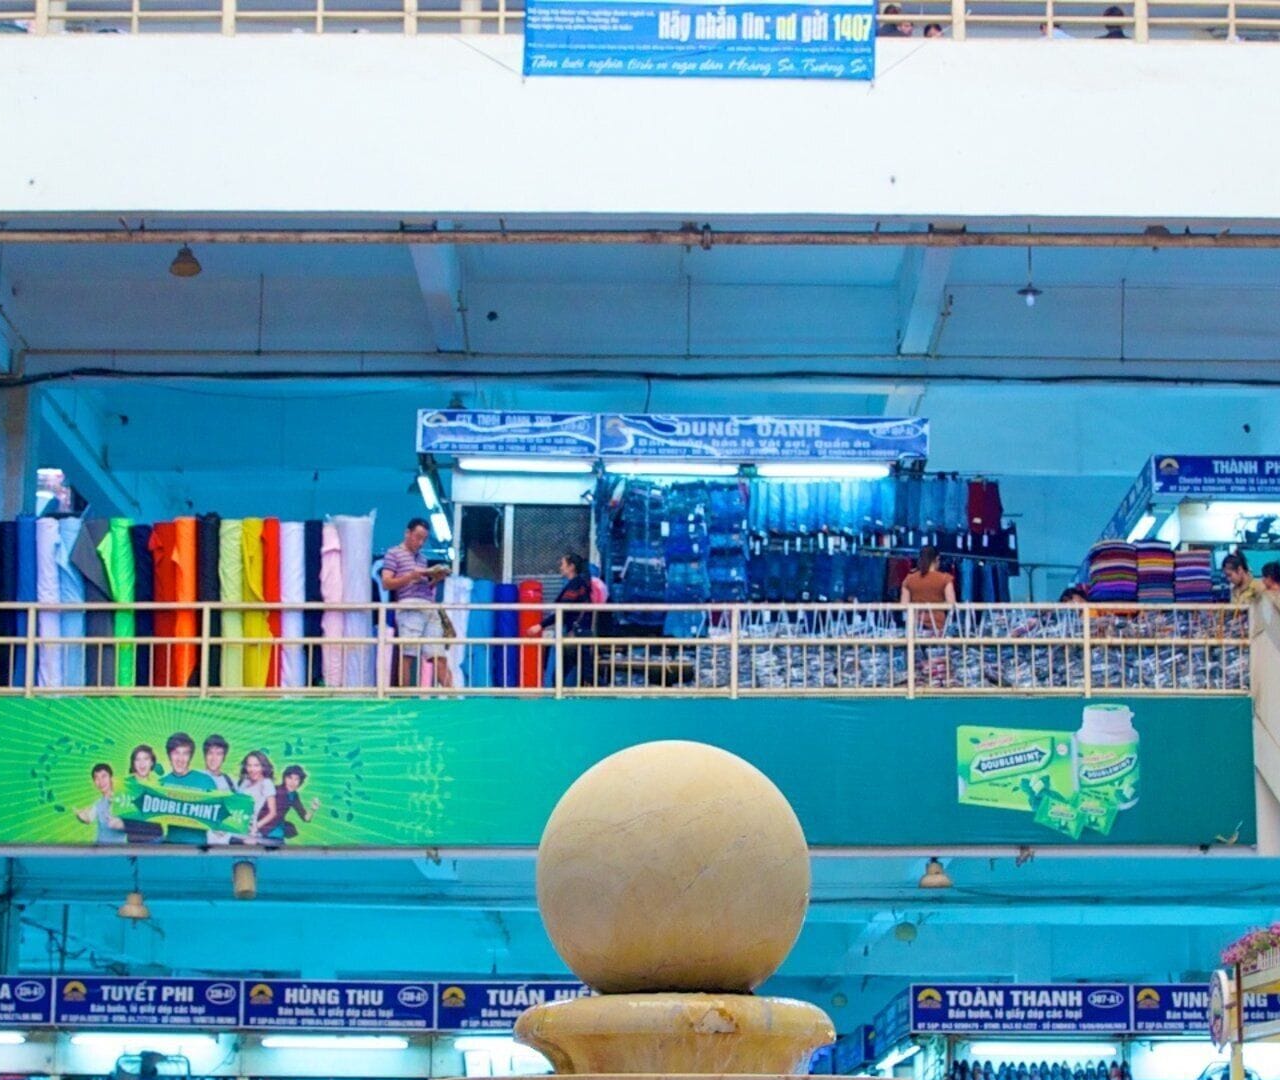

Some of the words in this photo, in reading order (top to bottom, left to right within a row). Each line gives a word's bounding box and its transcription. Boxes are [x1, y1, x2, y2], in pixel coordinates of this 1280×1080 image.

[981, 750, 1040, 771] DOUBLEMINT
[142, 794, 222, 822] DOUBLEMINT
[101, 981, 157, 1002] TUYẾT
[162, 986, 194, 1002] PHI
[285, 984, 340, 1005] HÙNG
[345, 989, 384, 1006] THU
[486, 983, 545, 1006] TUẤN
[946, 987, 1005, 1007] TOÀN
[1010, 990, 1083, 1007] THANH
